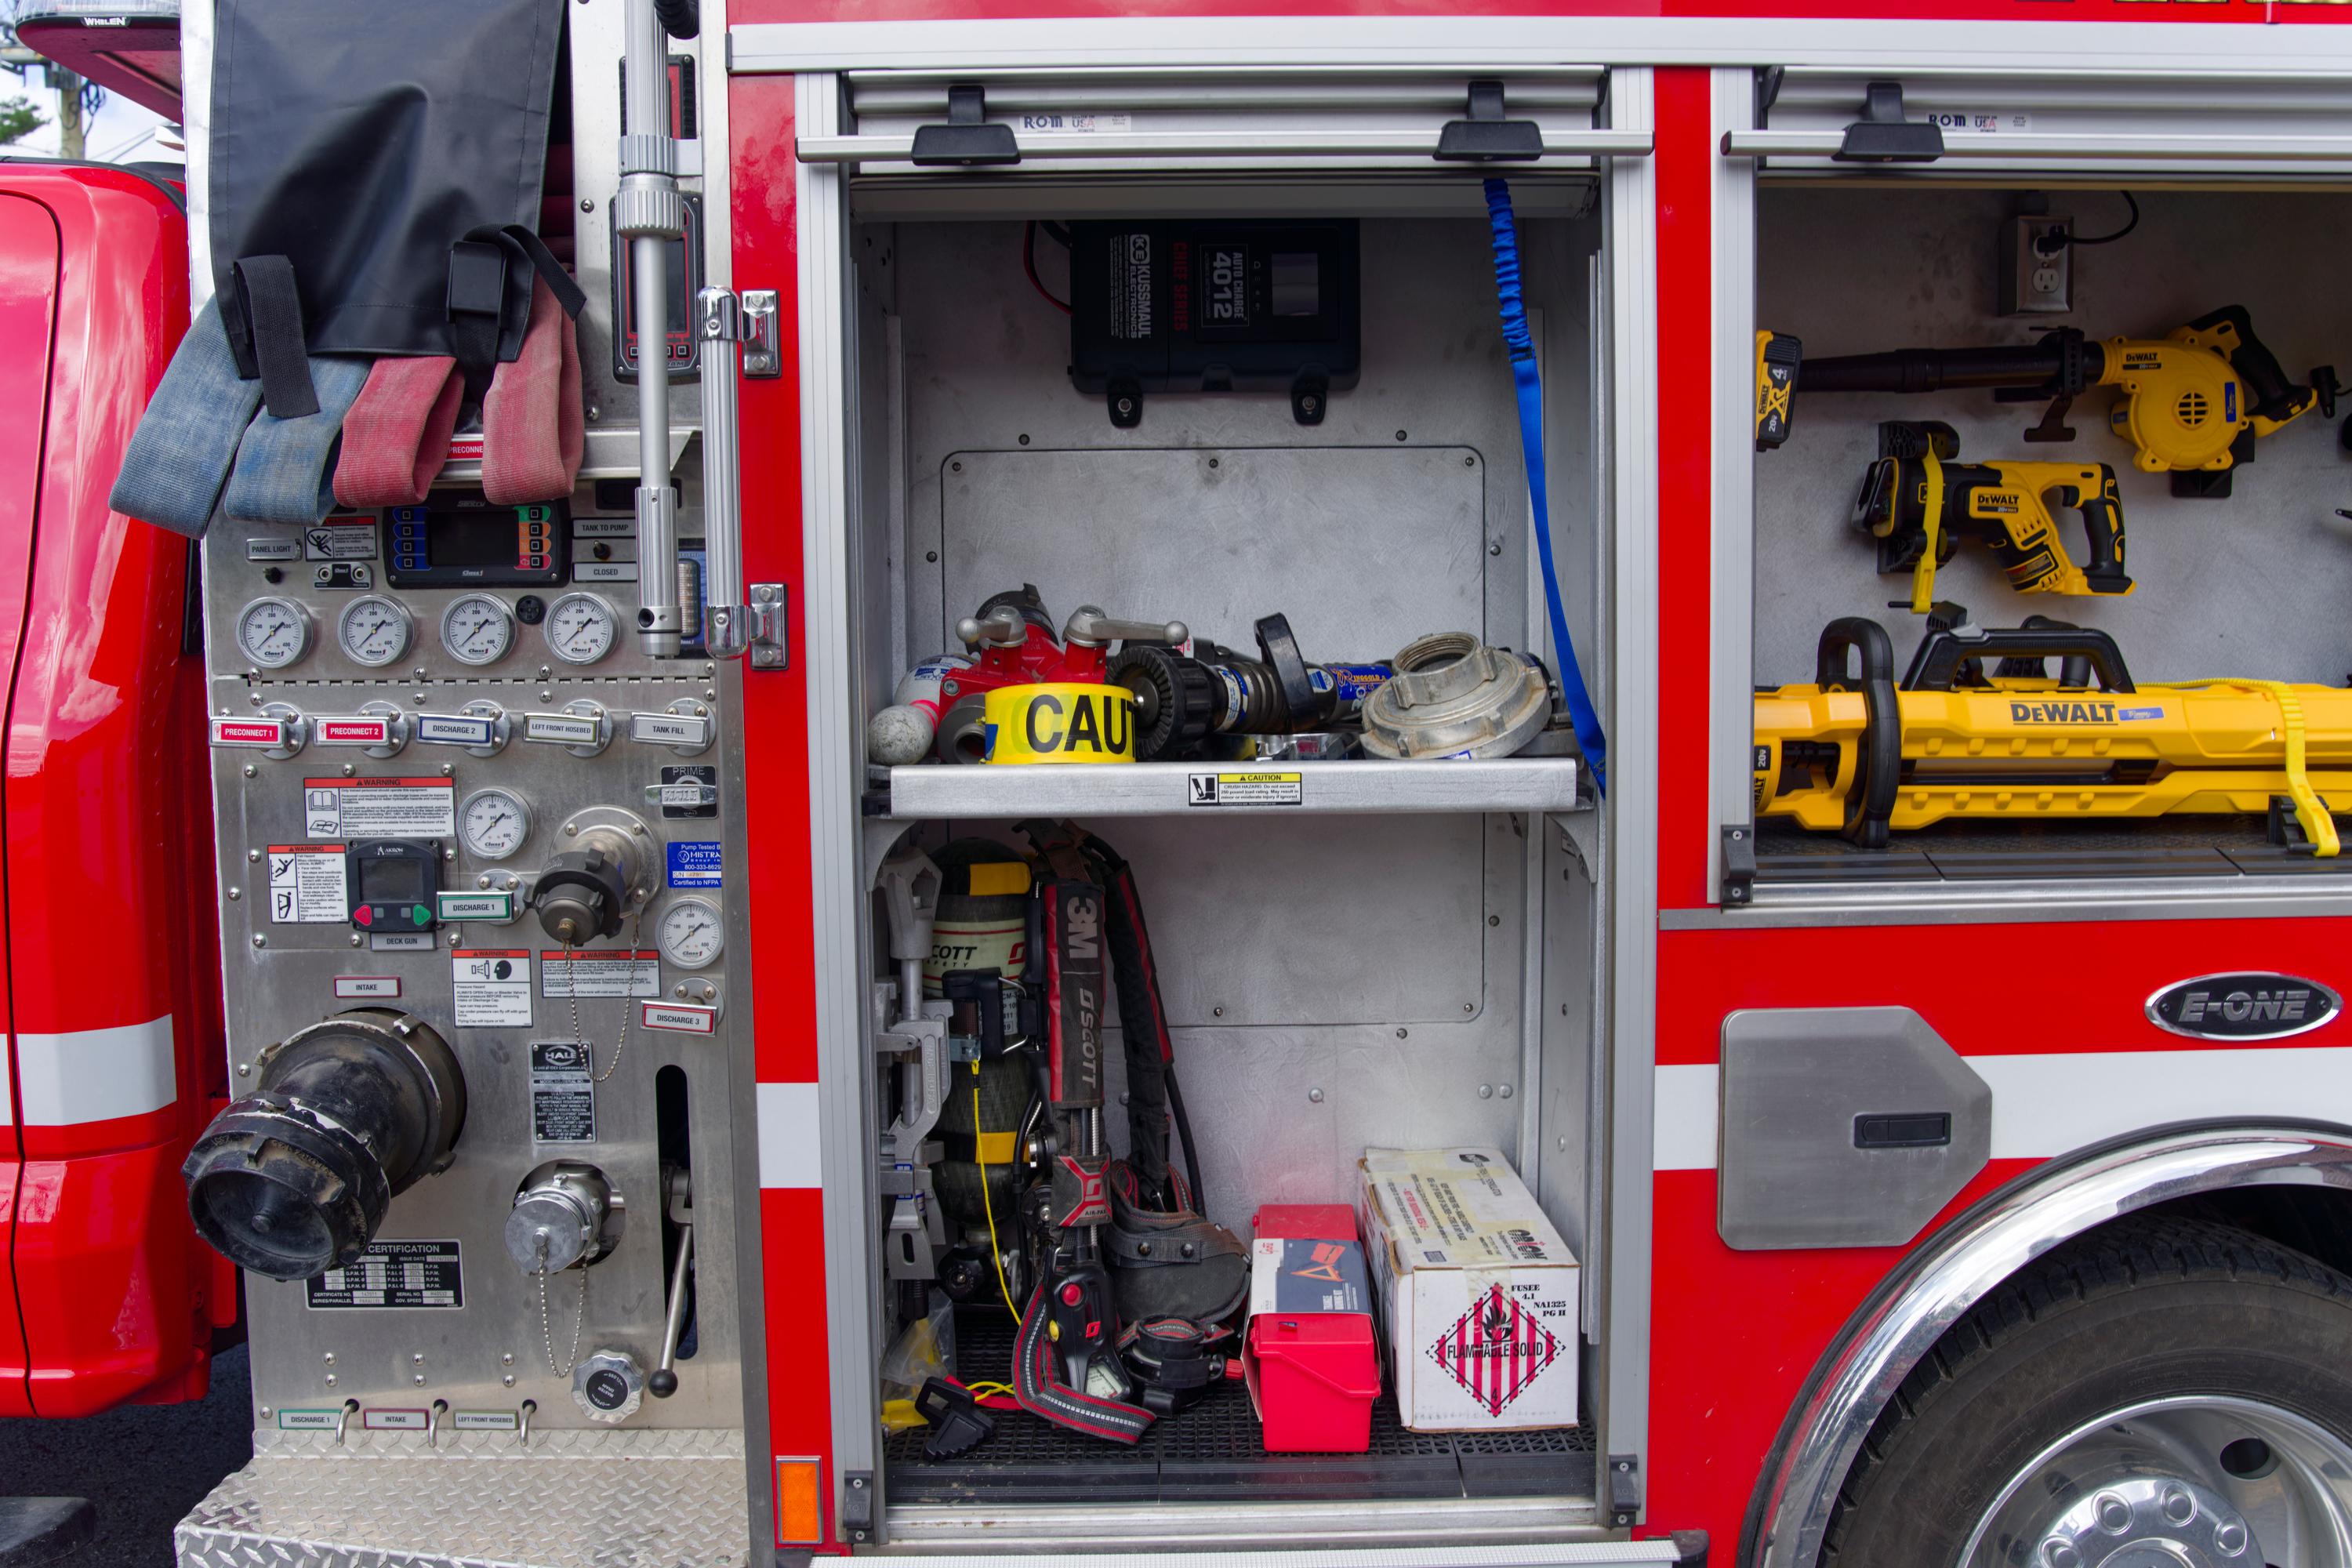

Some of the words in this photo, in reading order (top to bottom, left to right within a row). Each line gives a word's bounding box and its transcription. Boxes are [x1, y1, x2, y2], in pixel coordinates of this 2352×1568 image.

[1073, 119, 1095, 129] USA
[1975, 119, 1996, 128] USA
[1174, 242, 1188, 281] CHIEF
[1232, 252, 1243, 278] AUTO
[1213, 252, 1232, 318] 4012
[1138, 265, 1151, 338] KUSSMAUL
[1174, 285, 1189, 331] SERIES
[1233, 280, 1244, 318] CHARGE
[1772, 368, 1784, 380] 4
[225, 728, 267, 737] PRECONNECT
[433, 725, 470, 734] DISCHARGE
[1067, 897, 1098, 958] 3M
[932, 945, 978, 960] COTT
[2178, 990, 2310, 1022] E-ONE
[657, 1014, 693, 1025] DISCHARGE
[1081, 1013, 1096, 1089] SCOTT
[1447, 1344, 1510, 1359] FLAMMABLE
[1513, 1342, 1543, 1356] SOLID
[1491, 1388, 1497, 1401] 4
